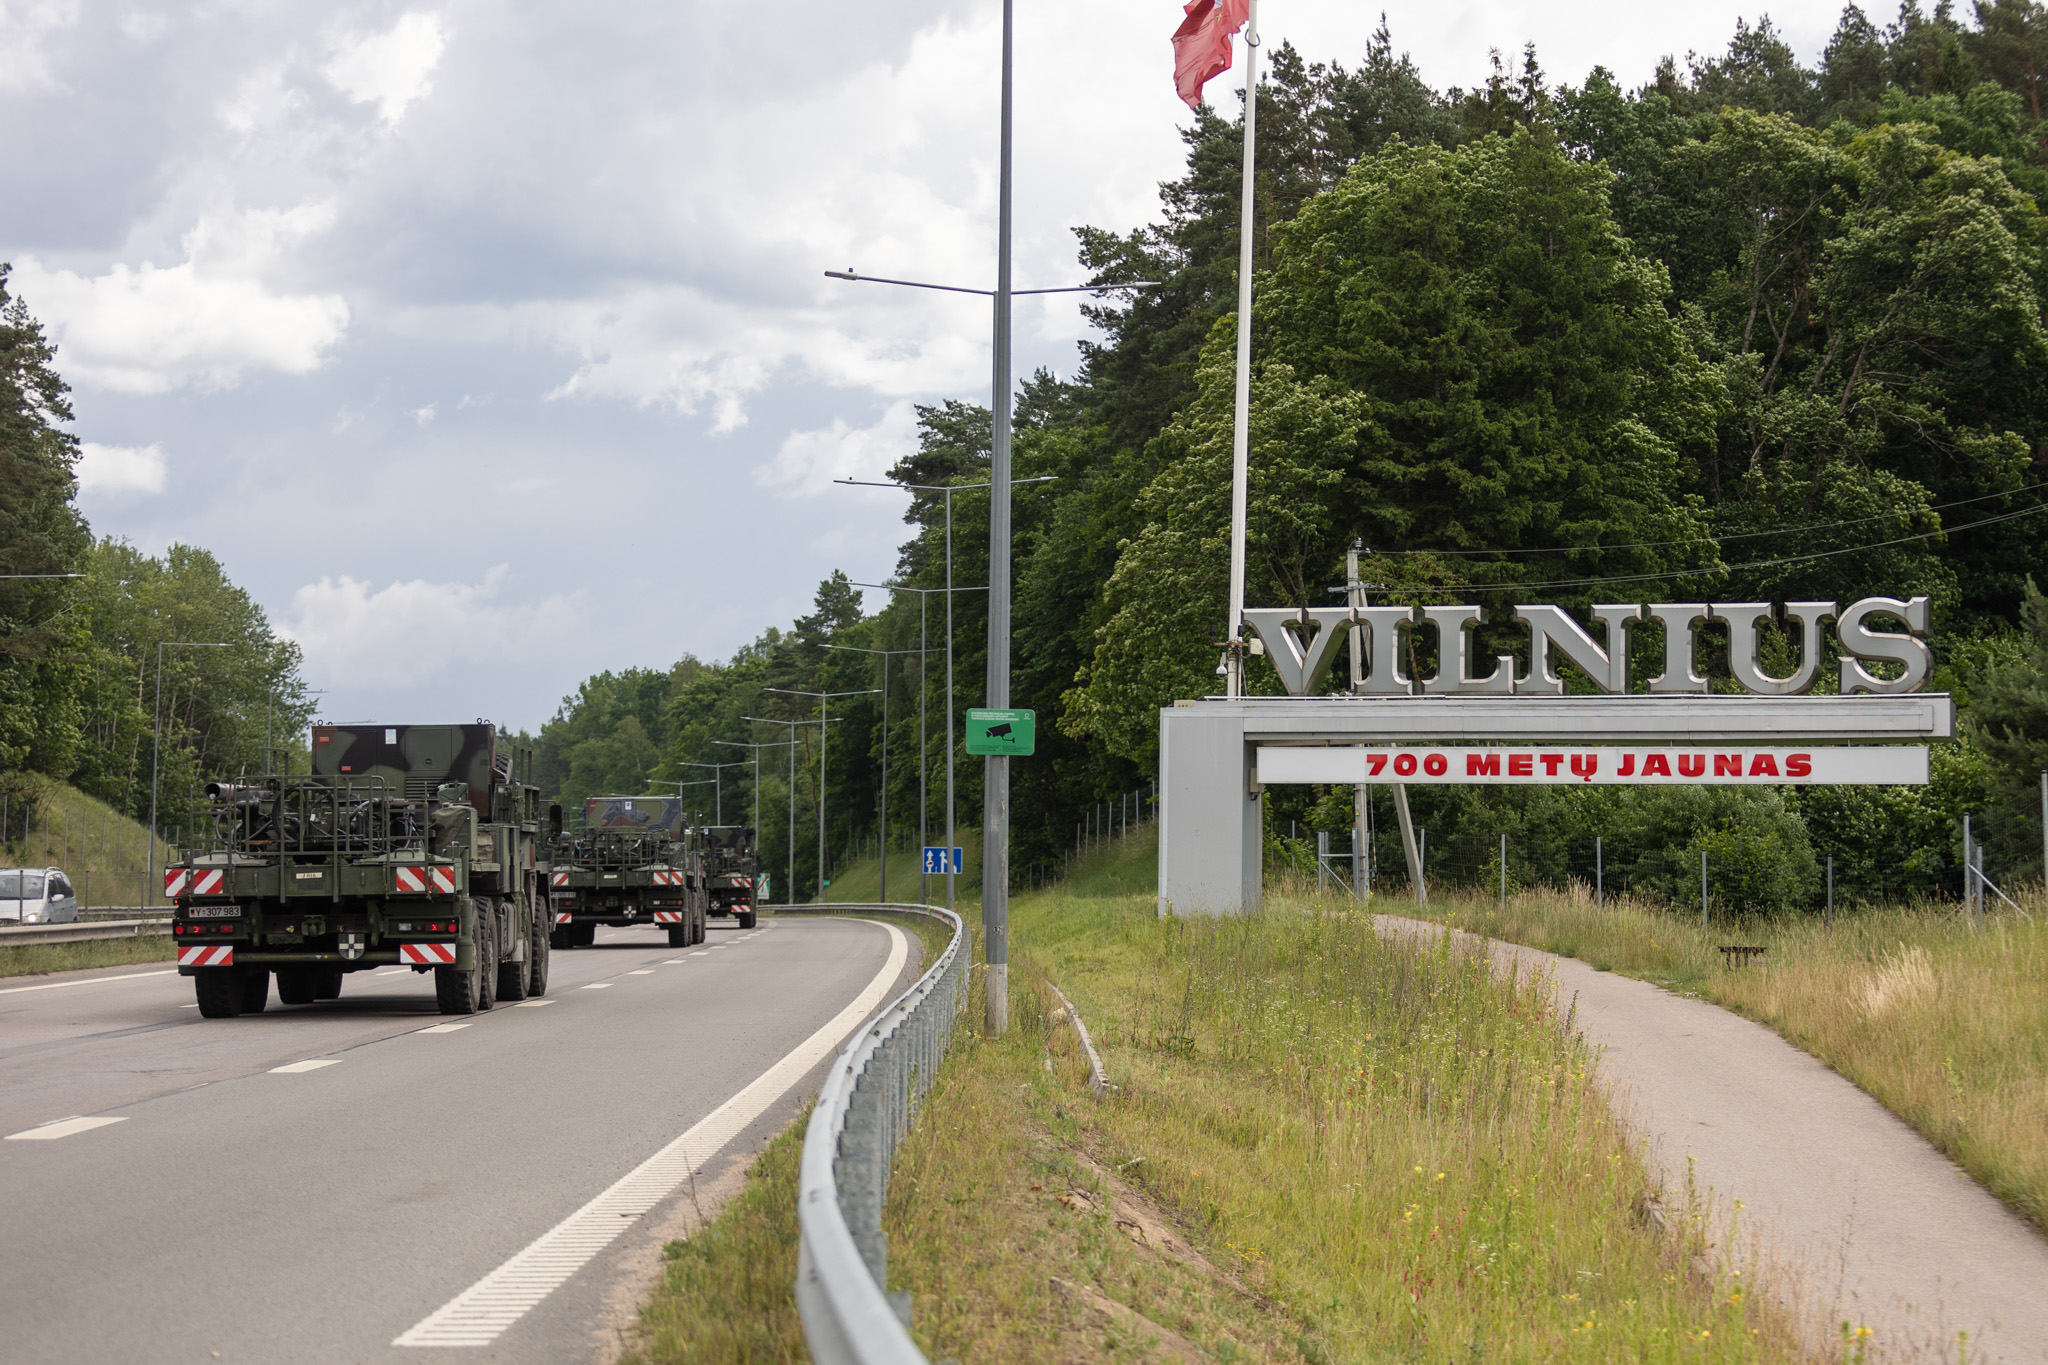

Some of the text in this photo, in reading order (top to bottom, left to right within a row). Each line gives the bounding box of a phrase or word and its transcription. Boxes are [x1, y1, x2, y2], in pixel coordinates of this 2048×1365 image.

[1241, 596, 1932, 695] VILNIUS
[1366, 753, 1813, 783] 700 METŲ JAUNAS
[223, 906, 240, 916] 983
